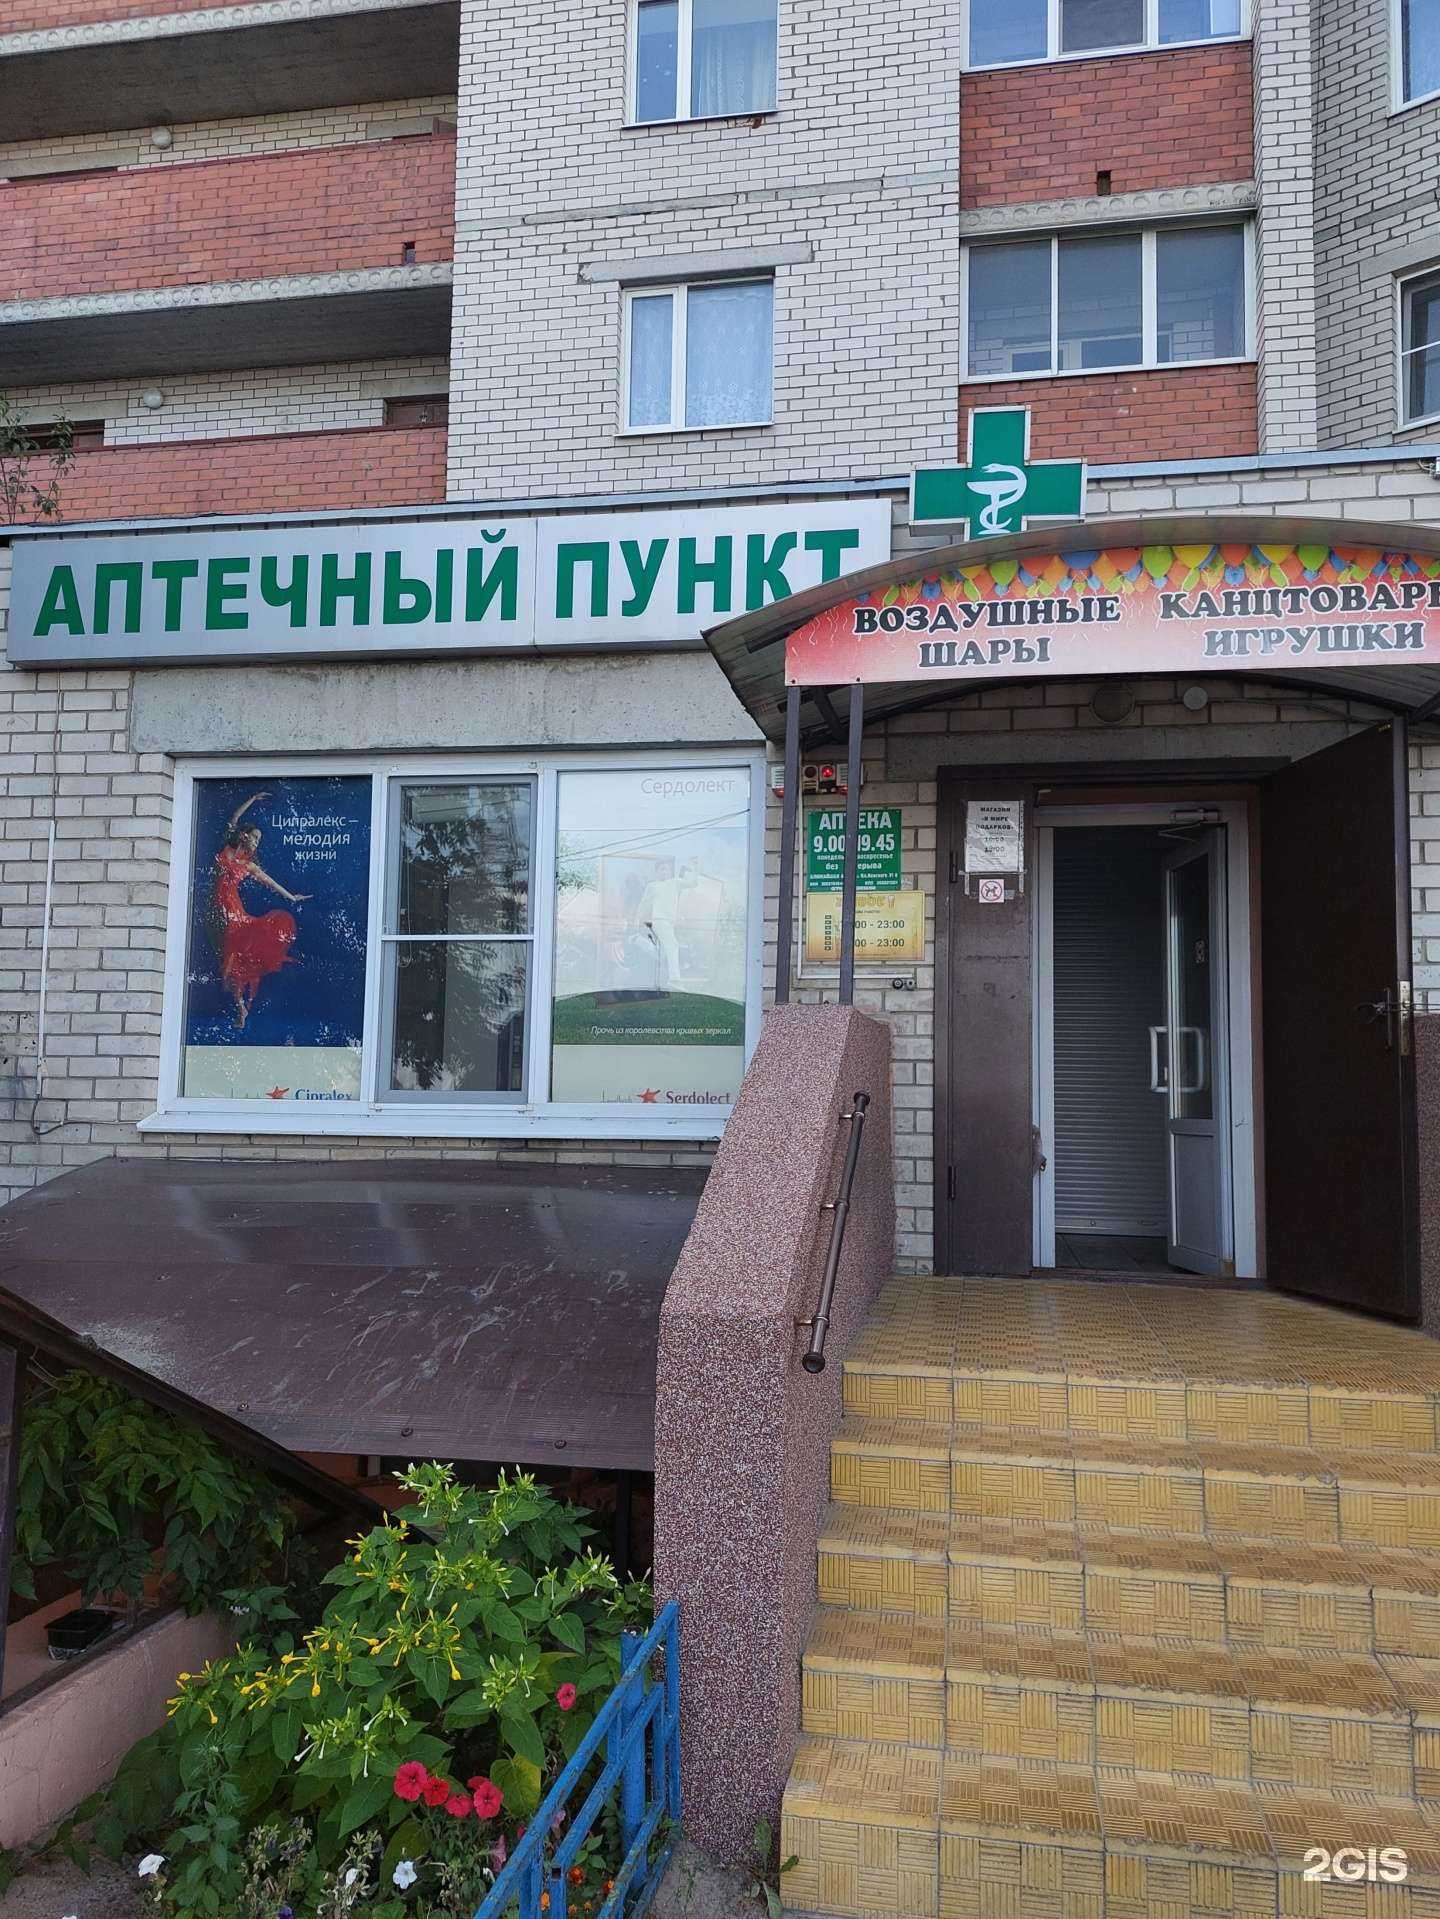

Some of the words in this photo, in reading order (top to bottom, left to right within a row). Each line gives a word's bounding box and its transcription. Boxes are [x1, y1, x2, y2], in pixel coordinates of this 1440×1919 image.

[33, 528, 519, 636] АПТЕЧНЫЙ
[556, 529, 859, 619] ПУНКТ
[853, 596, 1121, 633] ВОЗДУШНЫЕ
[1204, 622, 1425, 656] ИГРУШКИ
[919, 637, 1050, 667] ШАРЫ
[641, 778, 735, 798] Сердолект
[272, 815, 346, 832] Ципралекс
[819, 812, 892, 830] АПЕКА
[283, 834, 350, 848] мелодия
[295, 850, 337, 861] жизни
[825, 862, 838, 870] без
[877, 920, 905, 928] 23:00
[877, 939, 905, 947] 23:00
[591, 1025, 614, 1038] Прочь
[666, 1091, 731, 1104] Serdolect
